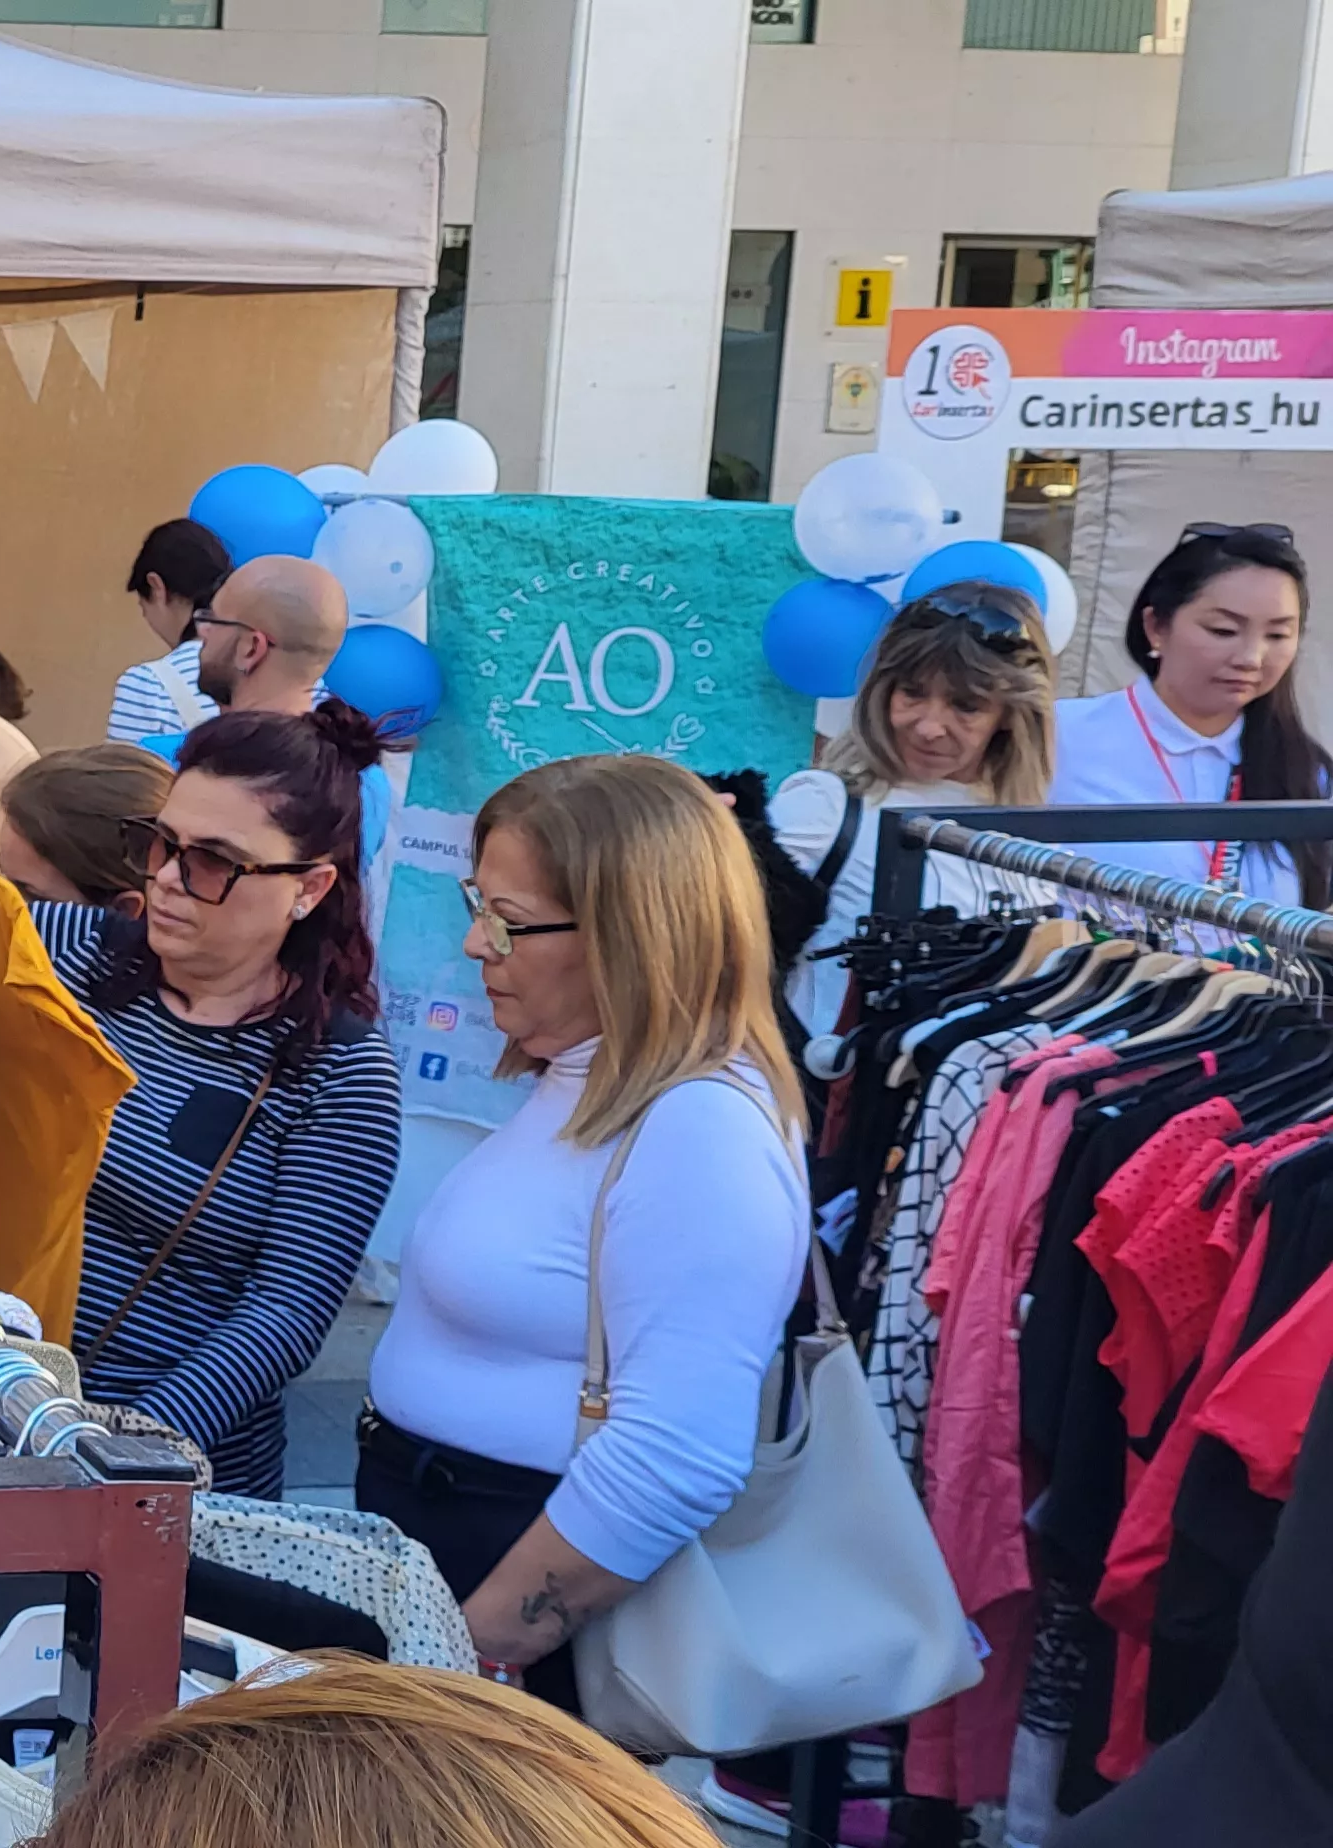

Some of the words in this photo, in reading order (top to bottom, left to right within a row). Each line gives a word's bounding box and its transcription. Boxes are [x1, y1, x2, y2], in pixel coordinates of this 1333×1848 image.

[1120, 326, 1282, 378] Instagram
[1020, 393, 1320, 433] Carinsertas_hu
[486, 575, 550, 643] ARTE
[567, 560, 713, 657] CREATIVO
[512, 621, 675, 716] AO
